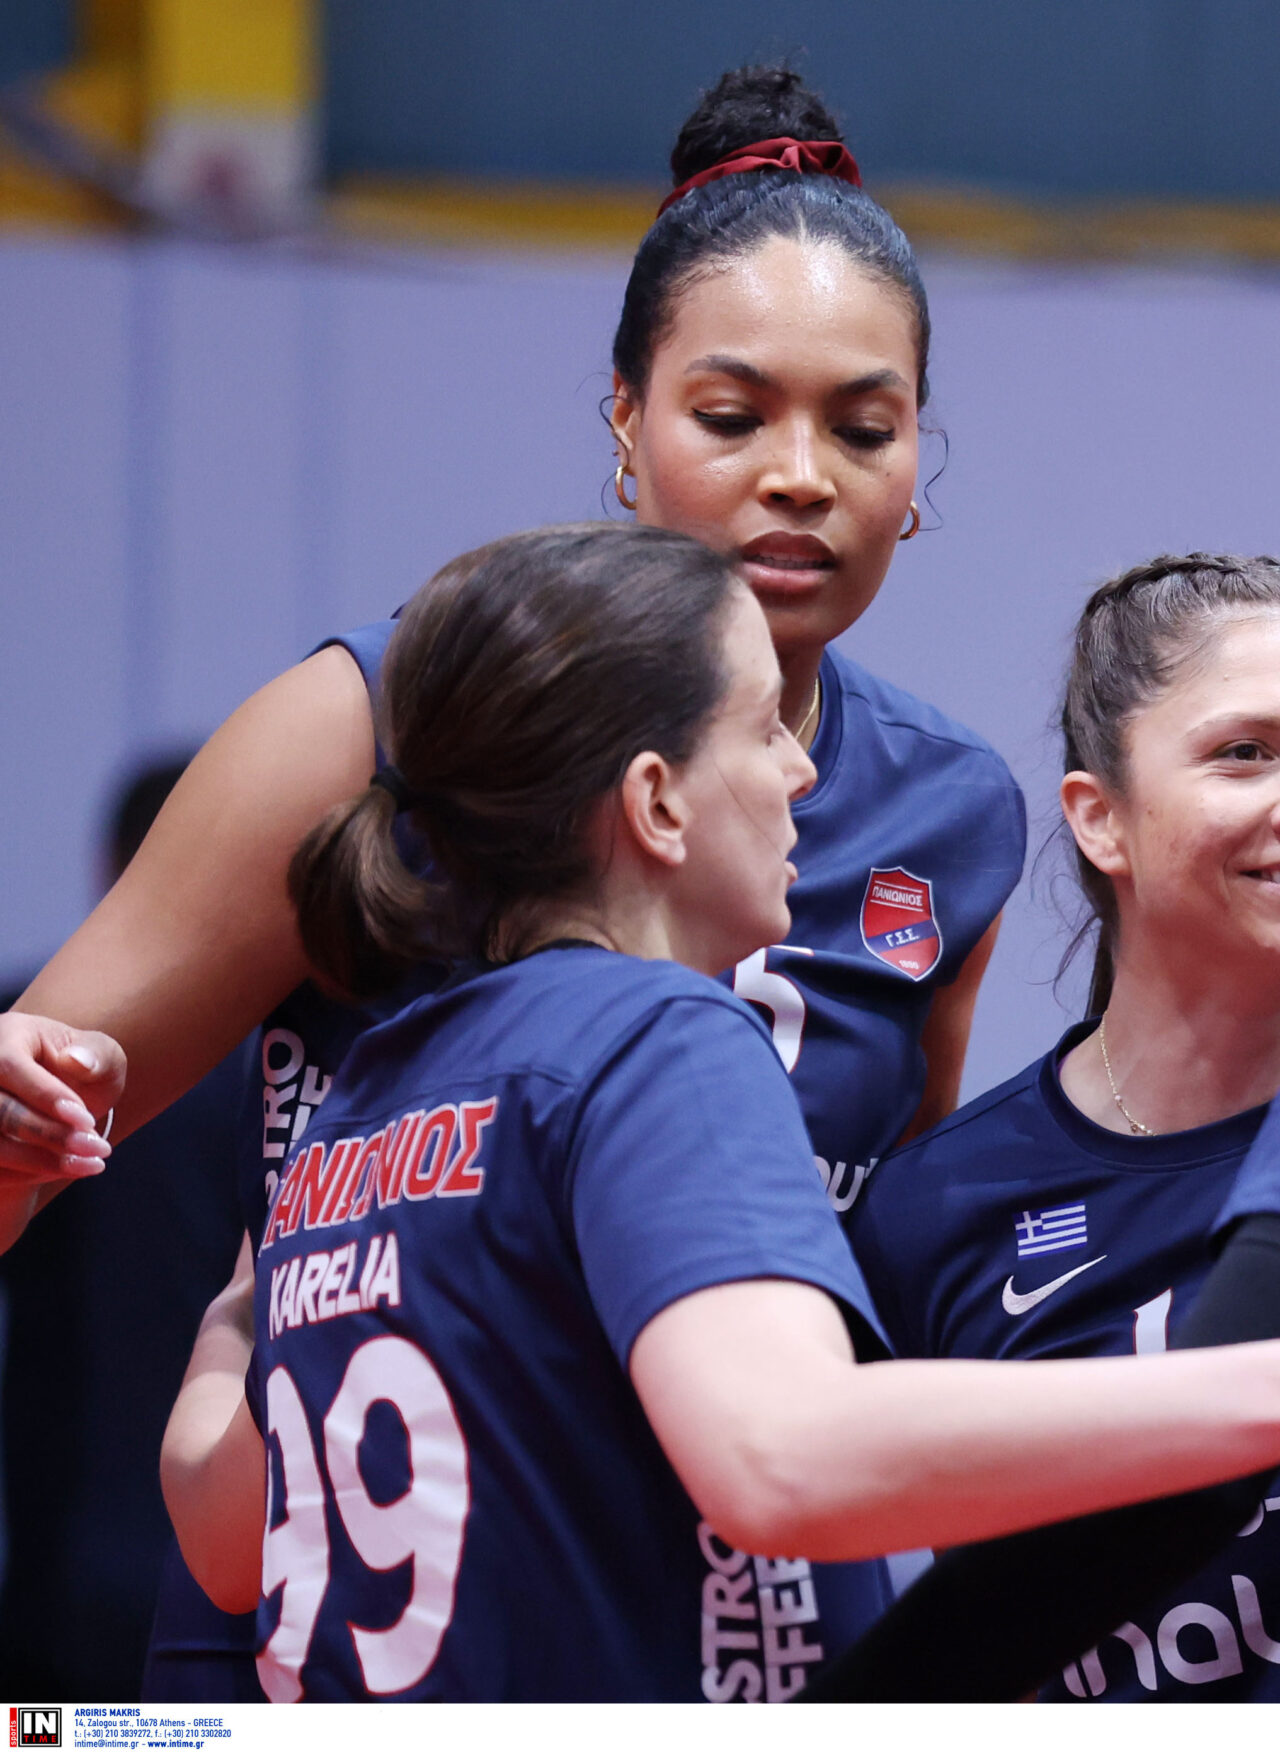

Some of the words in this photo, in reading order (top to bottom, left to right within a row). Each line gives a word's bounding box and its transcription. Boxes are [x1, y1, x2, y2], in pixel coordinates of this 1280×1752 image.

[872, 885, 924, 907] ΠΑΝΙΩΝΙΟΣ
[258, 1096, 498, 1257] ΑΝΙΩΝΙΟΣ
[268, 1231, 400, 1341] KARELIA
